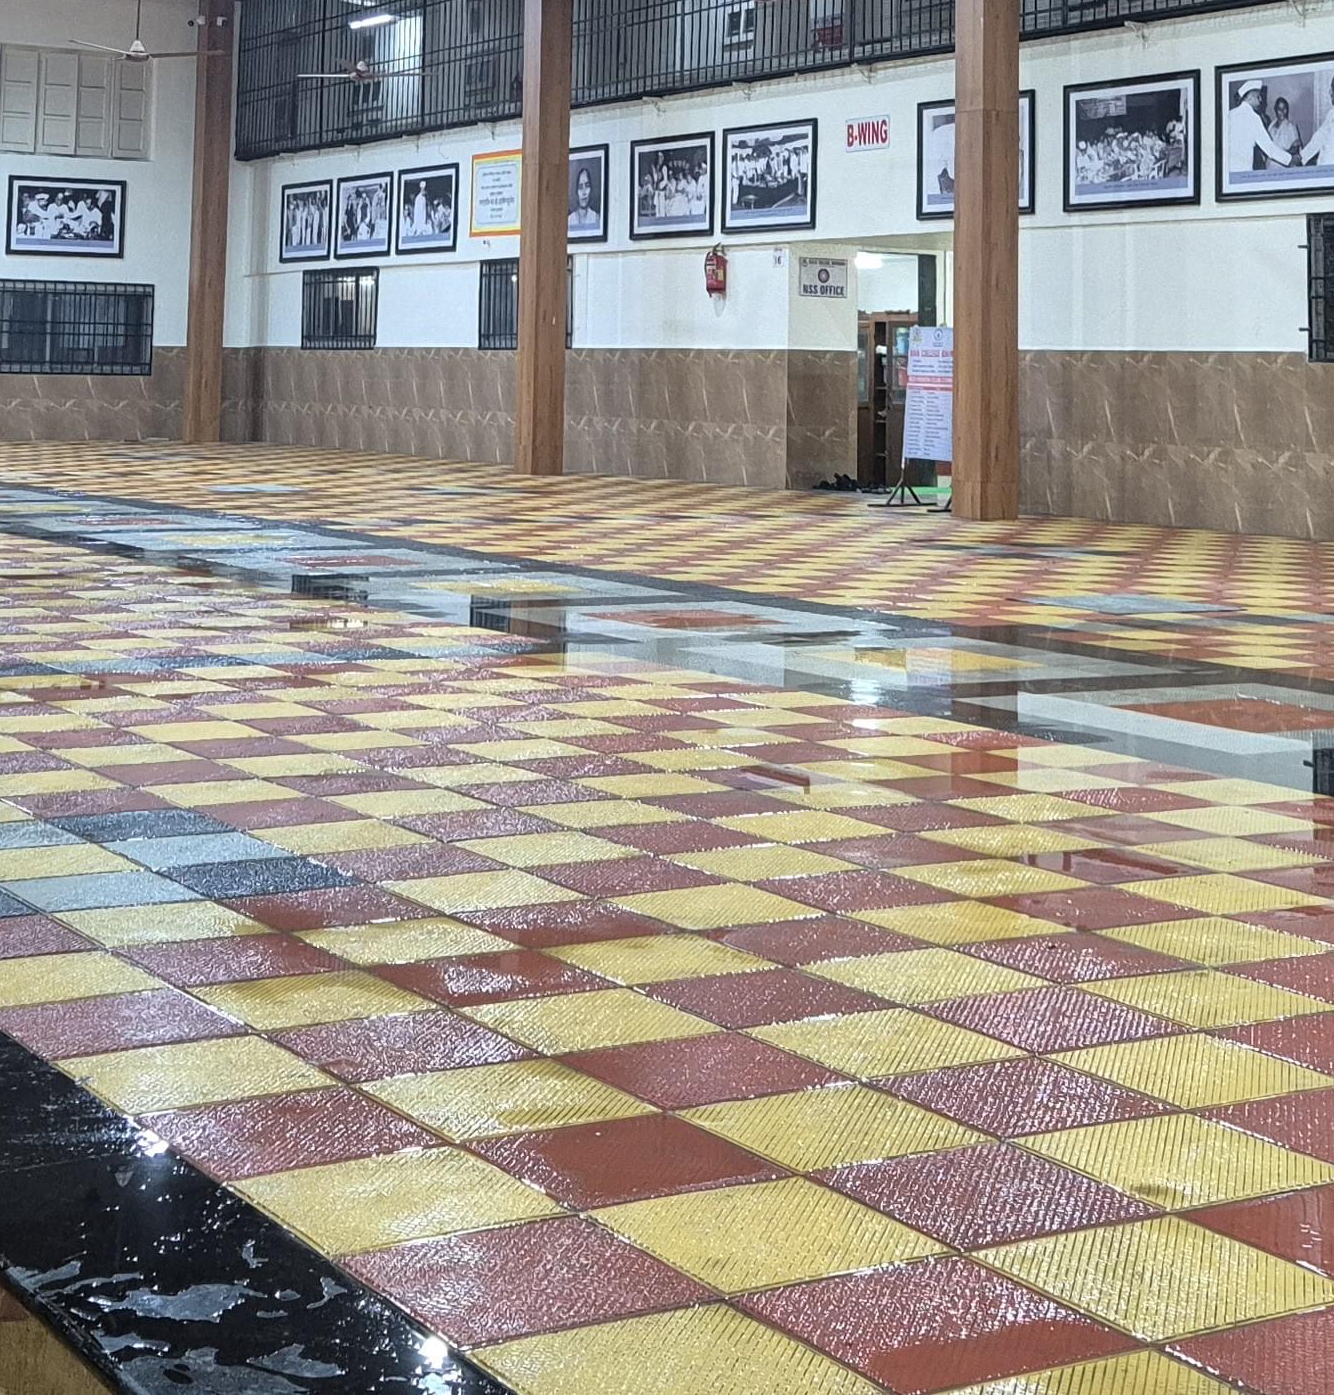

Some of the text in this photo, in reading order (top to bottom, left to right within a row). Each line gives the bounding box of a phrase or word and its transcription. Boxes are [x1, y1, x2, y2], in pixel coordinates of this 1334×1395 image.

[847, 119, 888, 147] B-WING
[803, 284, 845, 296] NSS OFFICE
